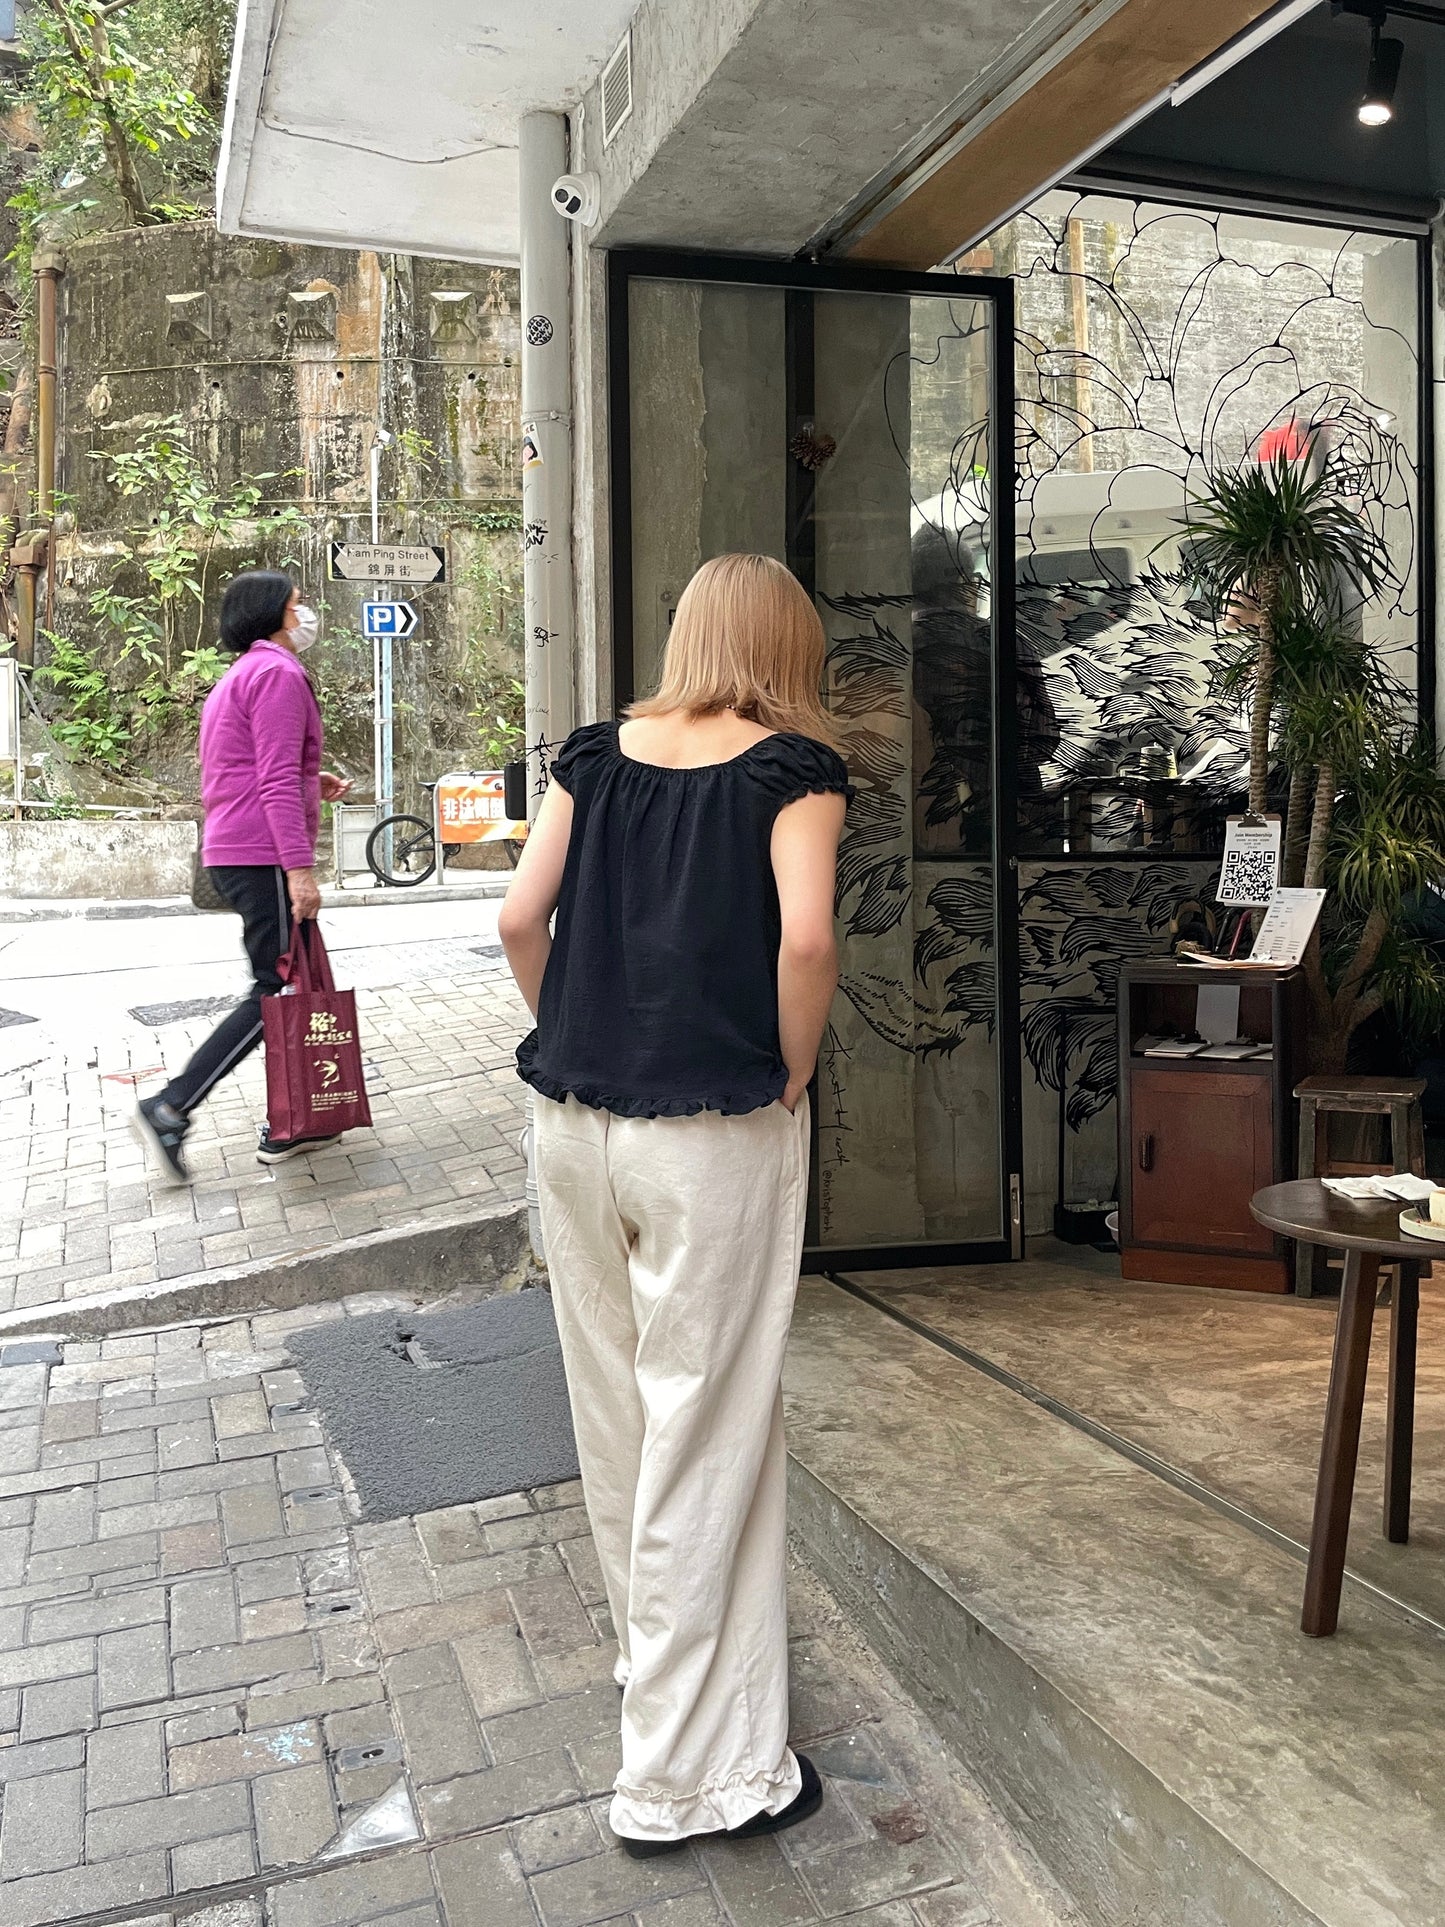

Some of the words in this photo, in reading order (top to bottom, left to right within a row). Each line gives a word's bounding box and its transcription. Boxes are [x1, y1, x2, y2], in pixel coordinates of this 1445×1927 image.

[373, 549, 395, 560] Ping
[398, 550, 429, 560] Street
[368, 563, 411, 577] 錦屏街
[373, 607, 392, 631] P
